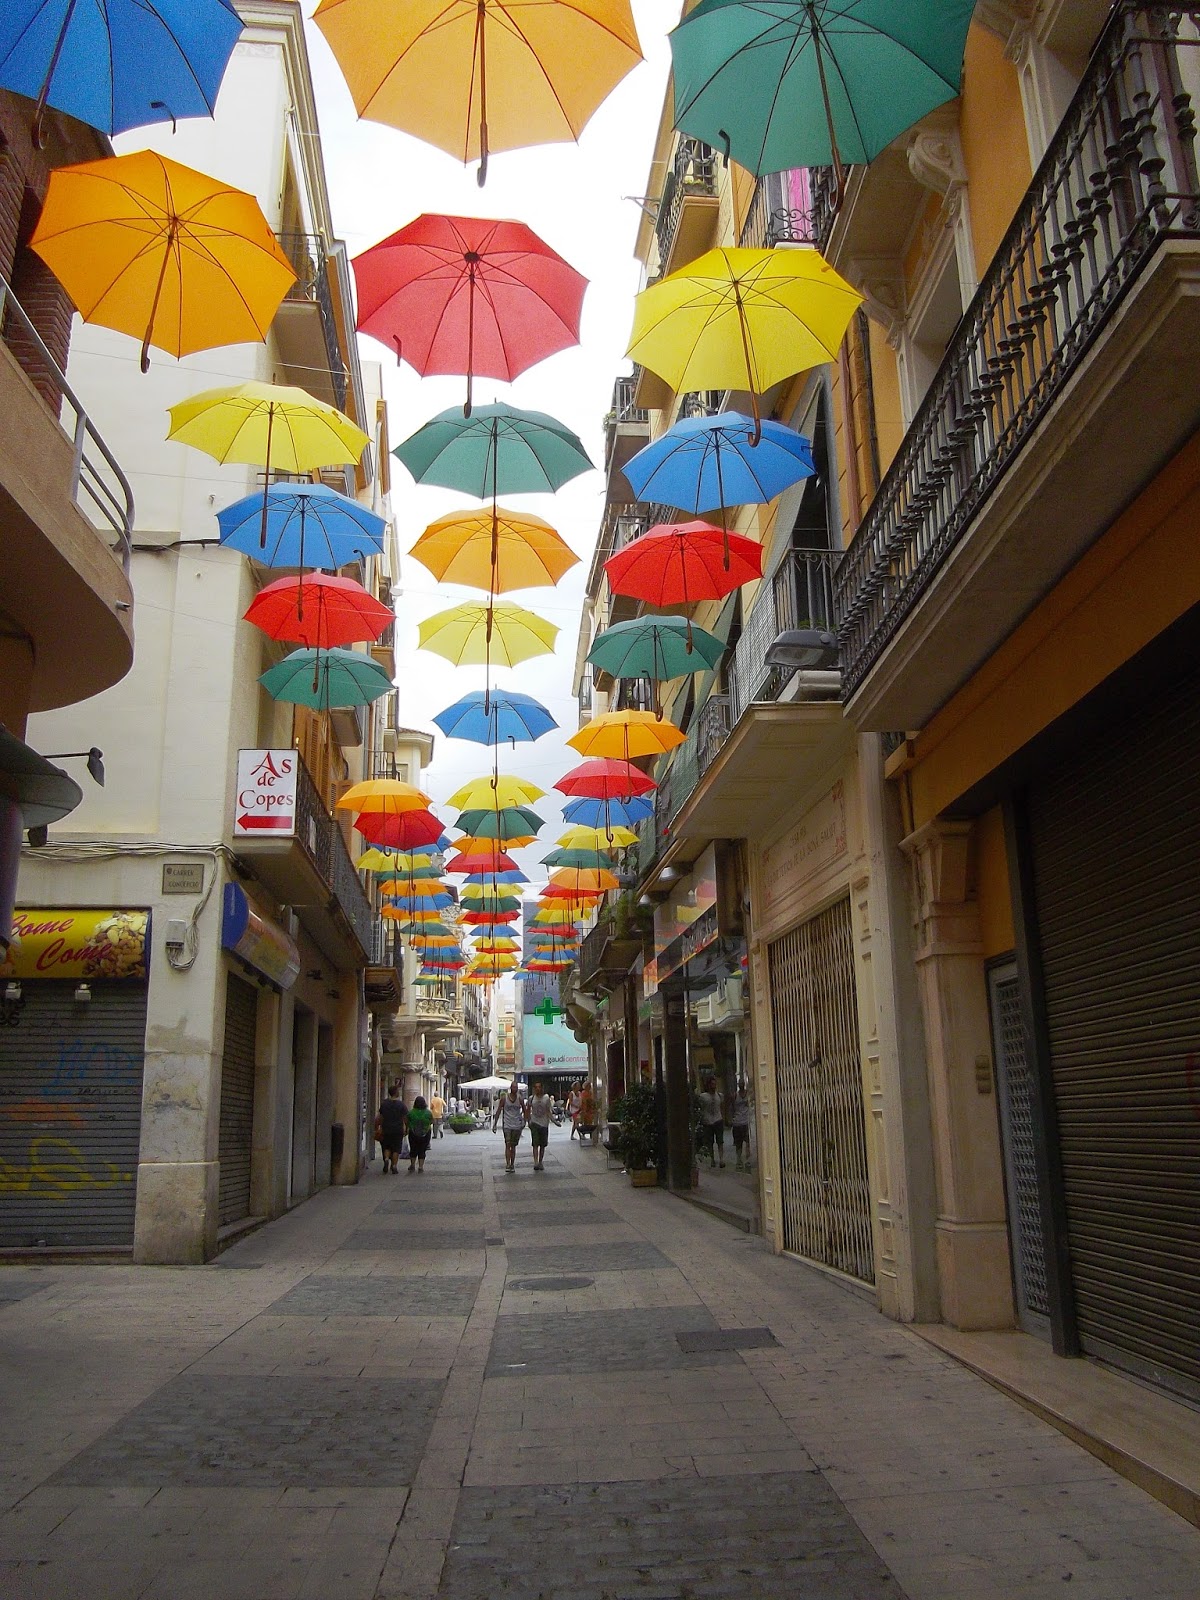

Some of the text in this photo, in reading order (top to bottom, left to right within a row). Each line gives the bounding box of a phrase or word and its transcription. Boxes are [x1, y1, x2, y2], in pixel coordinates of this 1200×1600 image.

[250, 751, 292, 778] As
[257, 771, 275, 786] de
[239, 789, 294, 811] Copes
[36, 938, 113, 971] Come
